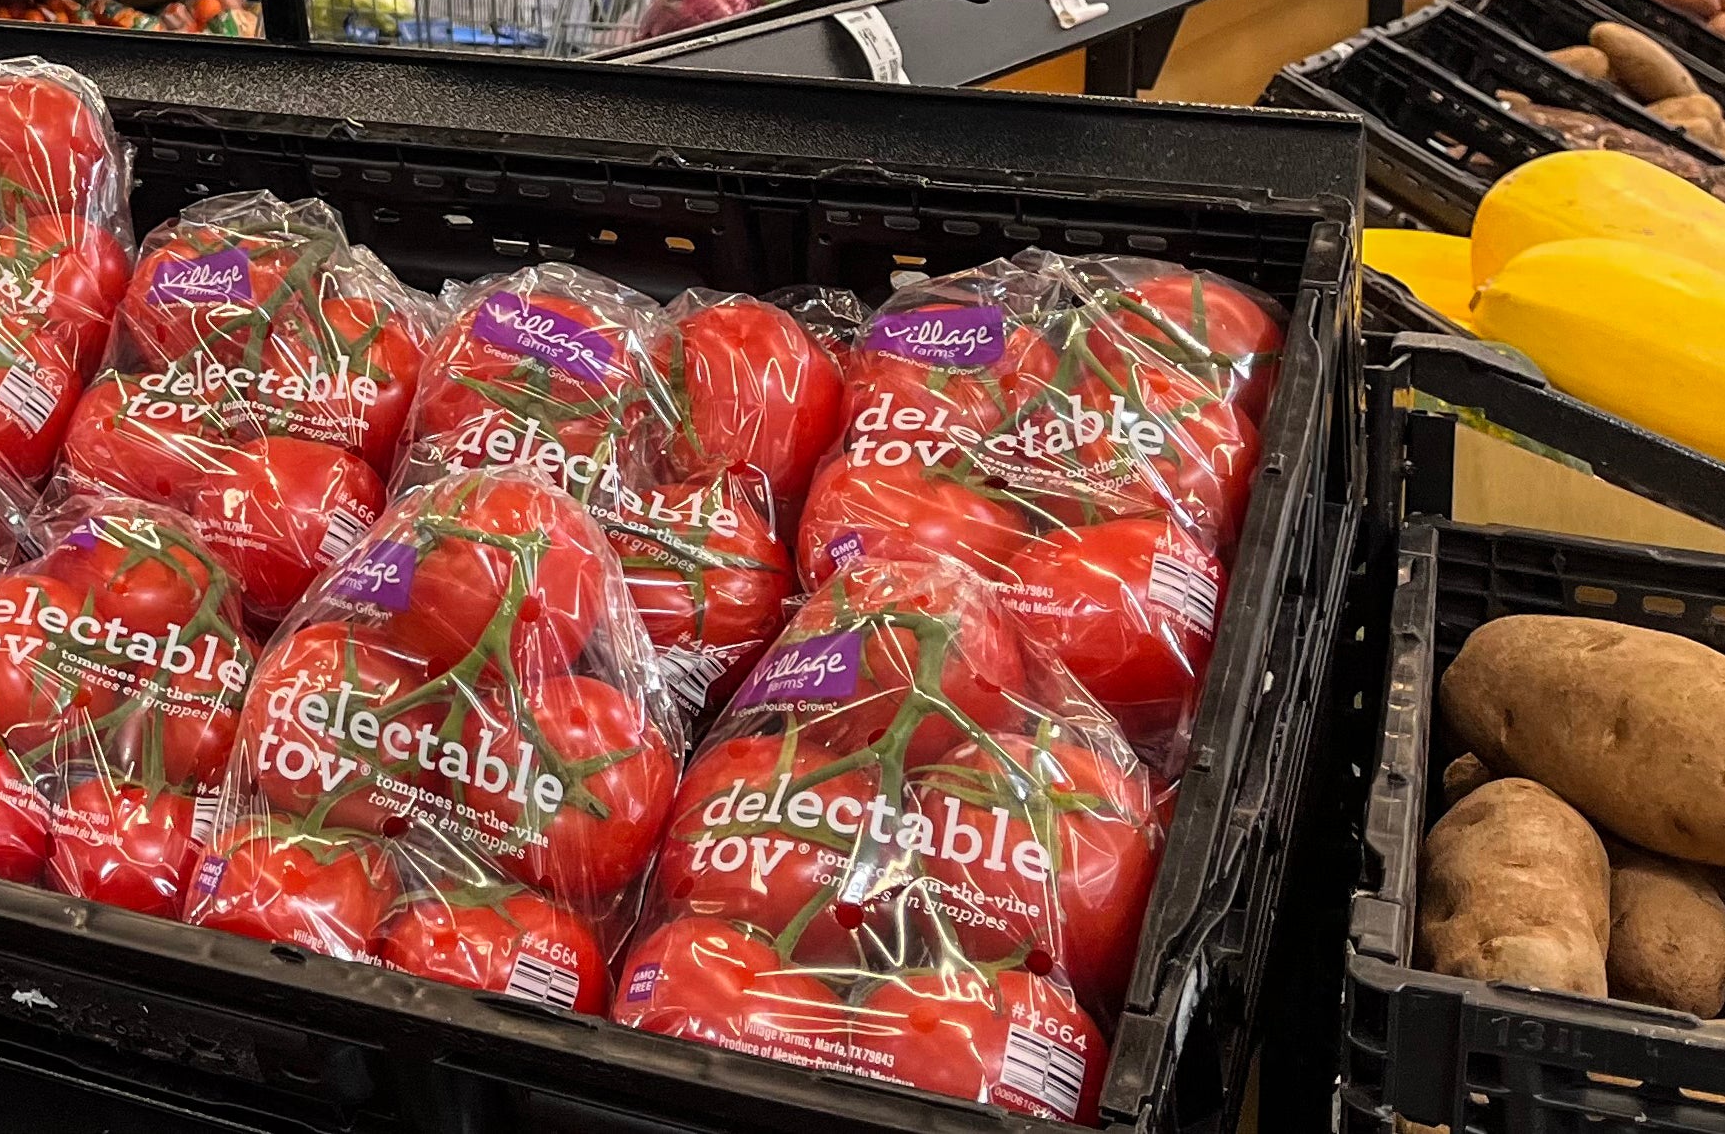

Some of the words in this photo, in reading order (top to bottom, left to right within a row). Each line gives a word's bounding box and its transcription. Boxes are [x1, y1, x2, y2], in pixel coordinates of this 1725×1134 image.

[163, 263, 243, 294] Village
[485, 302, 604, 363] Village
[516, 332, 560, 358] farms
[884, 319, 994, 356] Village
[911, 344, 955, 359] farms
[139, 350, 379, 407] delectable
[126, 392, 212, 424] tov
[287, 420, 349, 442] grappes
[855, 392, 1166, 459] delectable
[455, 408, 740, 539] delectable
[850, 435, 957, 468] tov
[1065, 456, 1139, 479] on-the-v
[630, 537, 697, 574] grappes
[830, 539, 857, 558] GMO
[1153, 534, 1219, 580] #4664
[56, 660, 121, 691] tomates
[122, 685, 143, 701] en
[142, 694, 210, 722] grappes
[60, 648, 137, 684] tomatoes
[138, 676, 234, 719] on-the-vine
[753, 650, 847, 688] Village
[797, 700, 834, 713] Grown
[257, 723, 358, 793] tov
[267, 668, 565, 814] delectable
[367, 790, 437, 826] tomates
[438, 817, 461, 835] en
[461, 824, 527, 861] grappes
[376, 772, 453, 812] tomatoes
[456, 801, 550, 849] on-the-vine
[701, 772, 1051, 884] delectable
[202, 862, 222, 877] GMO
[689, 830, 795, 877] tov
[812, 867, 893, 903] tomaes
[923, 896, 1009, 932] grappes
[816, 849, 915, 888] tomtoes
[919, 877, 1042, 918] on-the-vine
[629, 980, 653, 995] FREE
[632, 968, 657, 983] GMO
[718, 1034, 759, 1057] Produce
[760, 1044, 773, 1059] of
[743, 1020, 778, 1041] Village
[778, 1029, 812, 1050] Farms,
[814, 1036, 847, 1058] Marfa,
[862, 1046, 896, 1068] 79843
[1011, 1001, 1088, 1053] #4664
